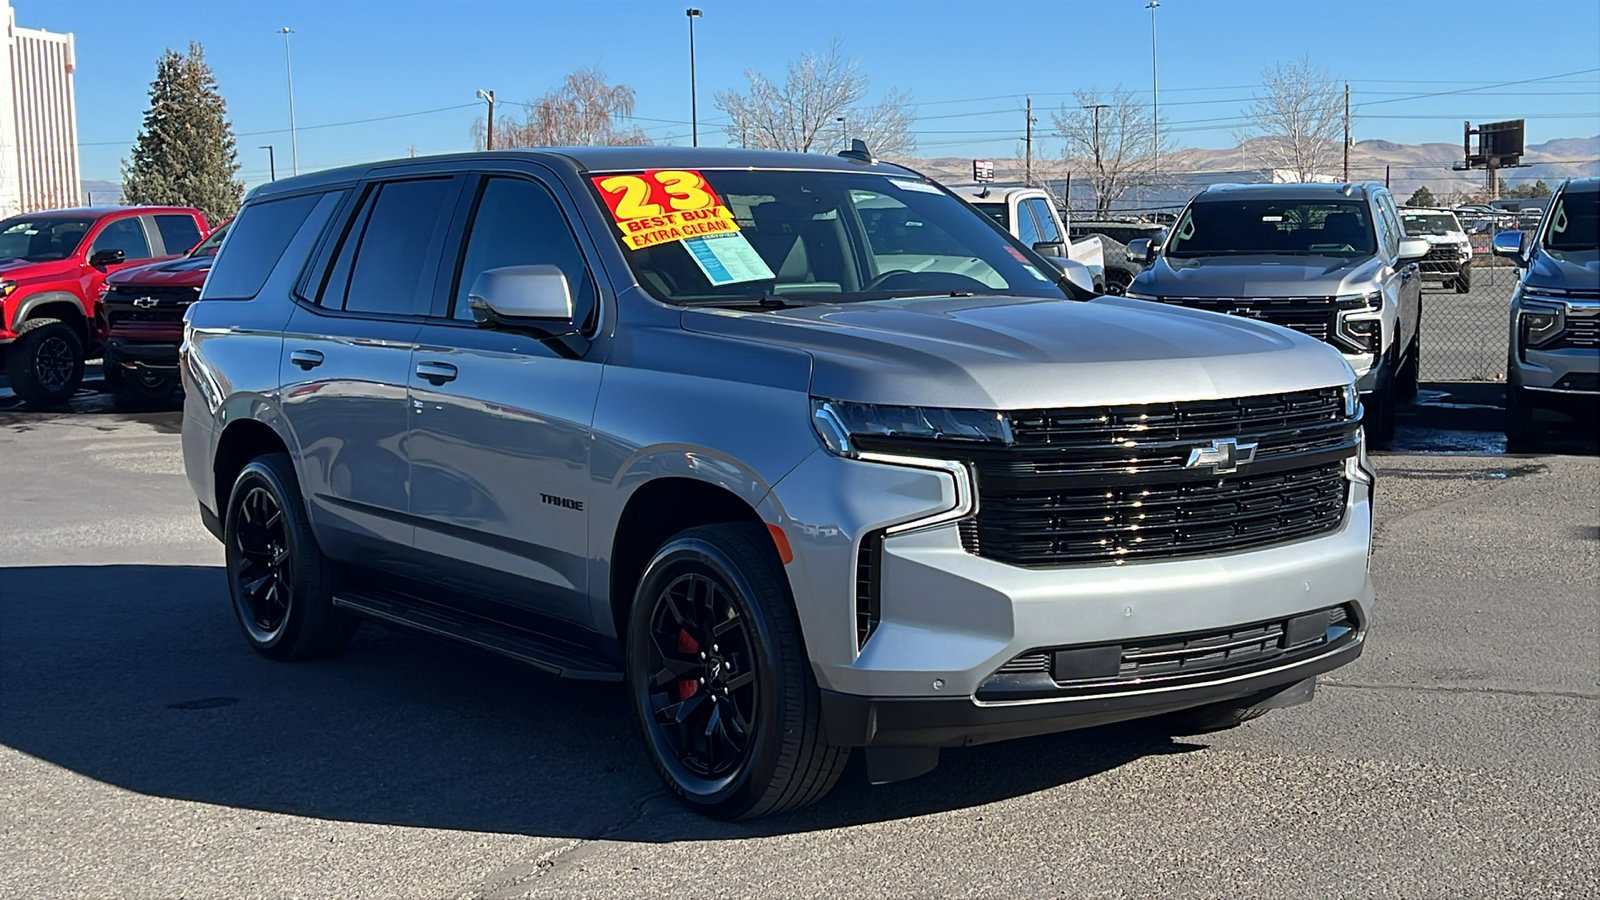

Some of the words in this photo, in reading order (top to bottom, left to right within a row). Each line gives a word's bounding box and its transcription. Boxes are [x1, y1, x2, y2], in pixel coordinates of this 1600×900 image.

[600, 171, 715, 219] 23
[626, 214, 676, 233] BEST
[681, 208, 720, 222] BUY
[632, 228, 681, 247] EXTRA
[682, 220, 729, 236] CLEAN
[539, 493, 584, 511] TAHOE
